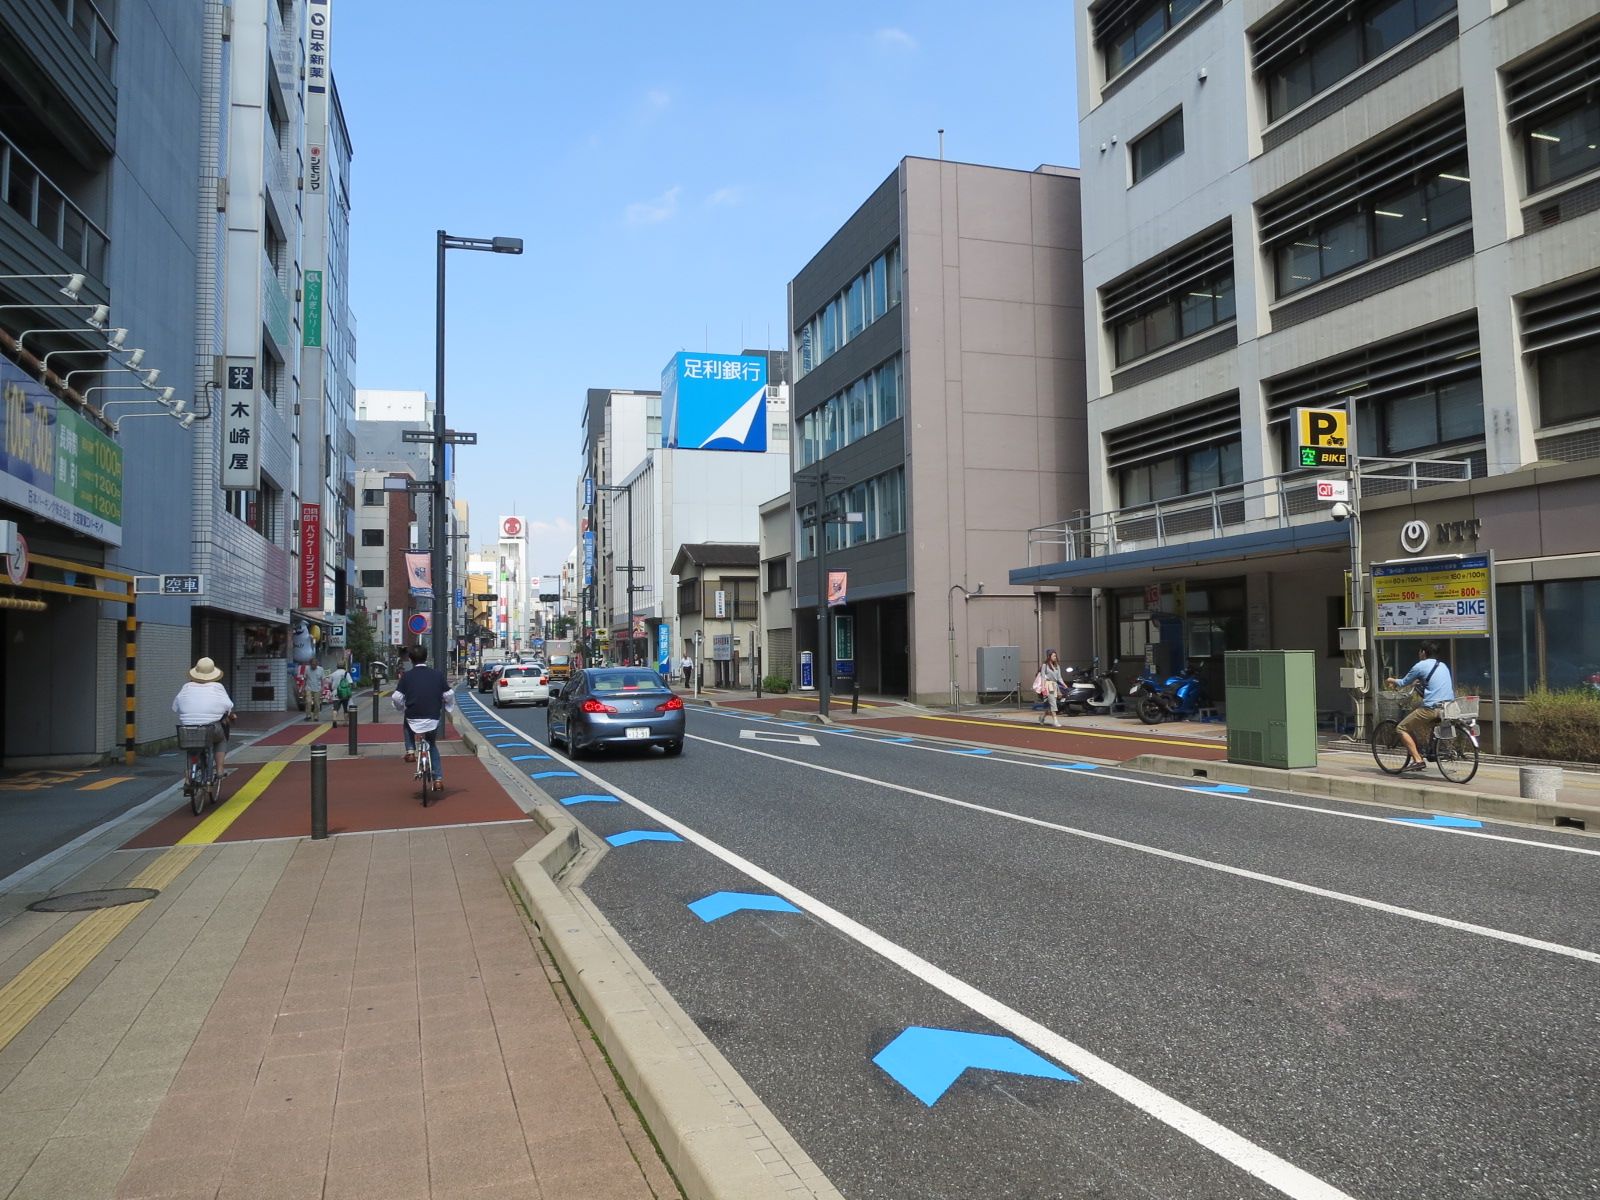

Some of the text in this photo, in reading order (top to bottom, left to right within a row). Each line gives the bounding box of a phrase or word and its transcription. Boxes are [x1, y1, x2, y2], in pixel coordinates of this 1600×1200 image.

[310, 30, 324, 78] 日本新薬
[310, 156, 320, 190] シモジマ
[308, 284, 318, 345] ぐんぎんリース
[684, 359, 760, 382] 足利銀行
[228, 401, 250, 470] 木崎屋
[1308, 412, 1338, 446] P
[1302, 448, 1316, 465] 空
[1322, 454, 1346, 462] BIKE
[1436, 518, 1482, 544] NTT
[305, 524, 314, 586] パッケージプラザ
[166, 578, 198, 592] 空車
[1457, 600, 1486, 616] BIKE
